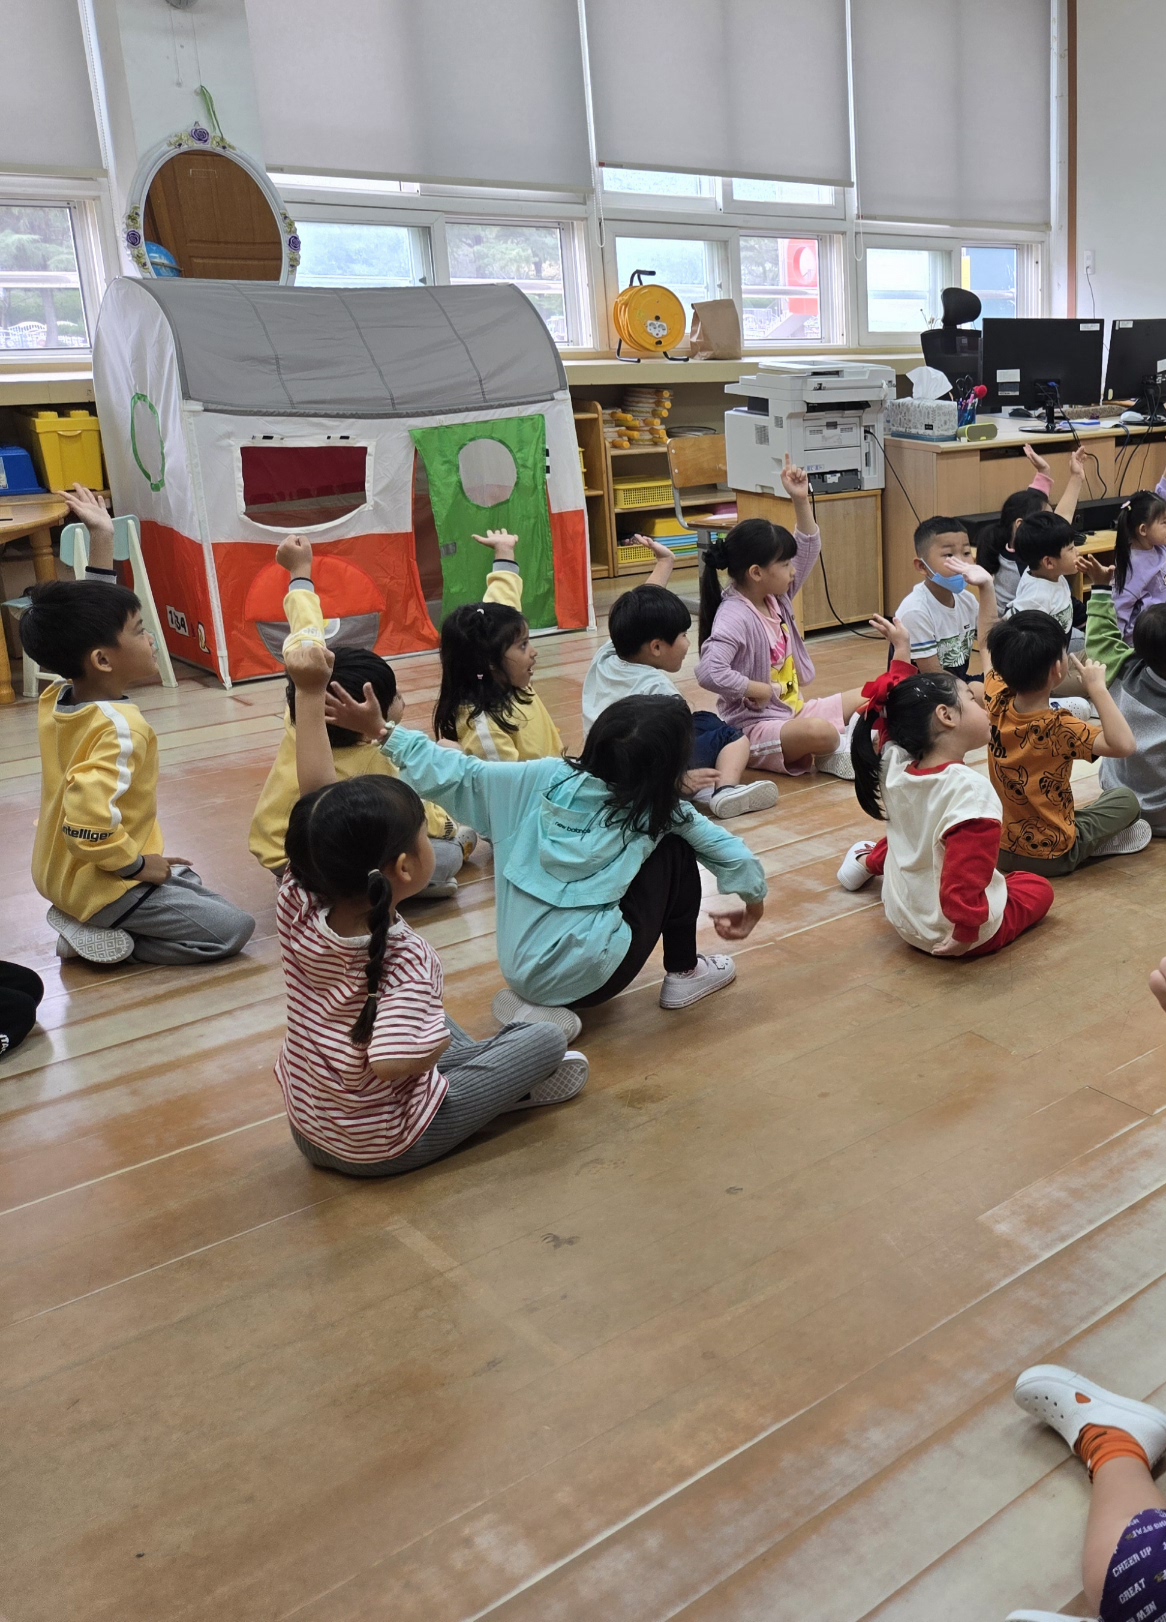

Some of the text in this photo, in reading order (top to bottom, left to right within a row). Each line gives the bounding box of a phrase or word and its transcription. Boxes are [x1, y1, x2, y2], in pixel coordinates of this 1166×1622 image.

[555, 821, 566, 829] new
[1112, 1546, 1152, 1577] CHEER UP
